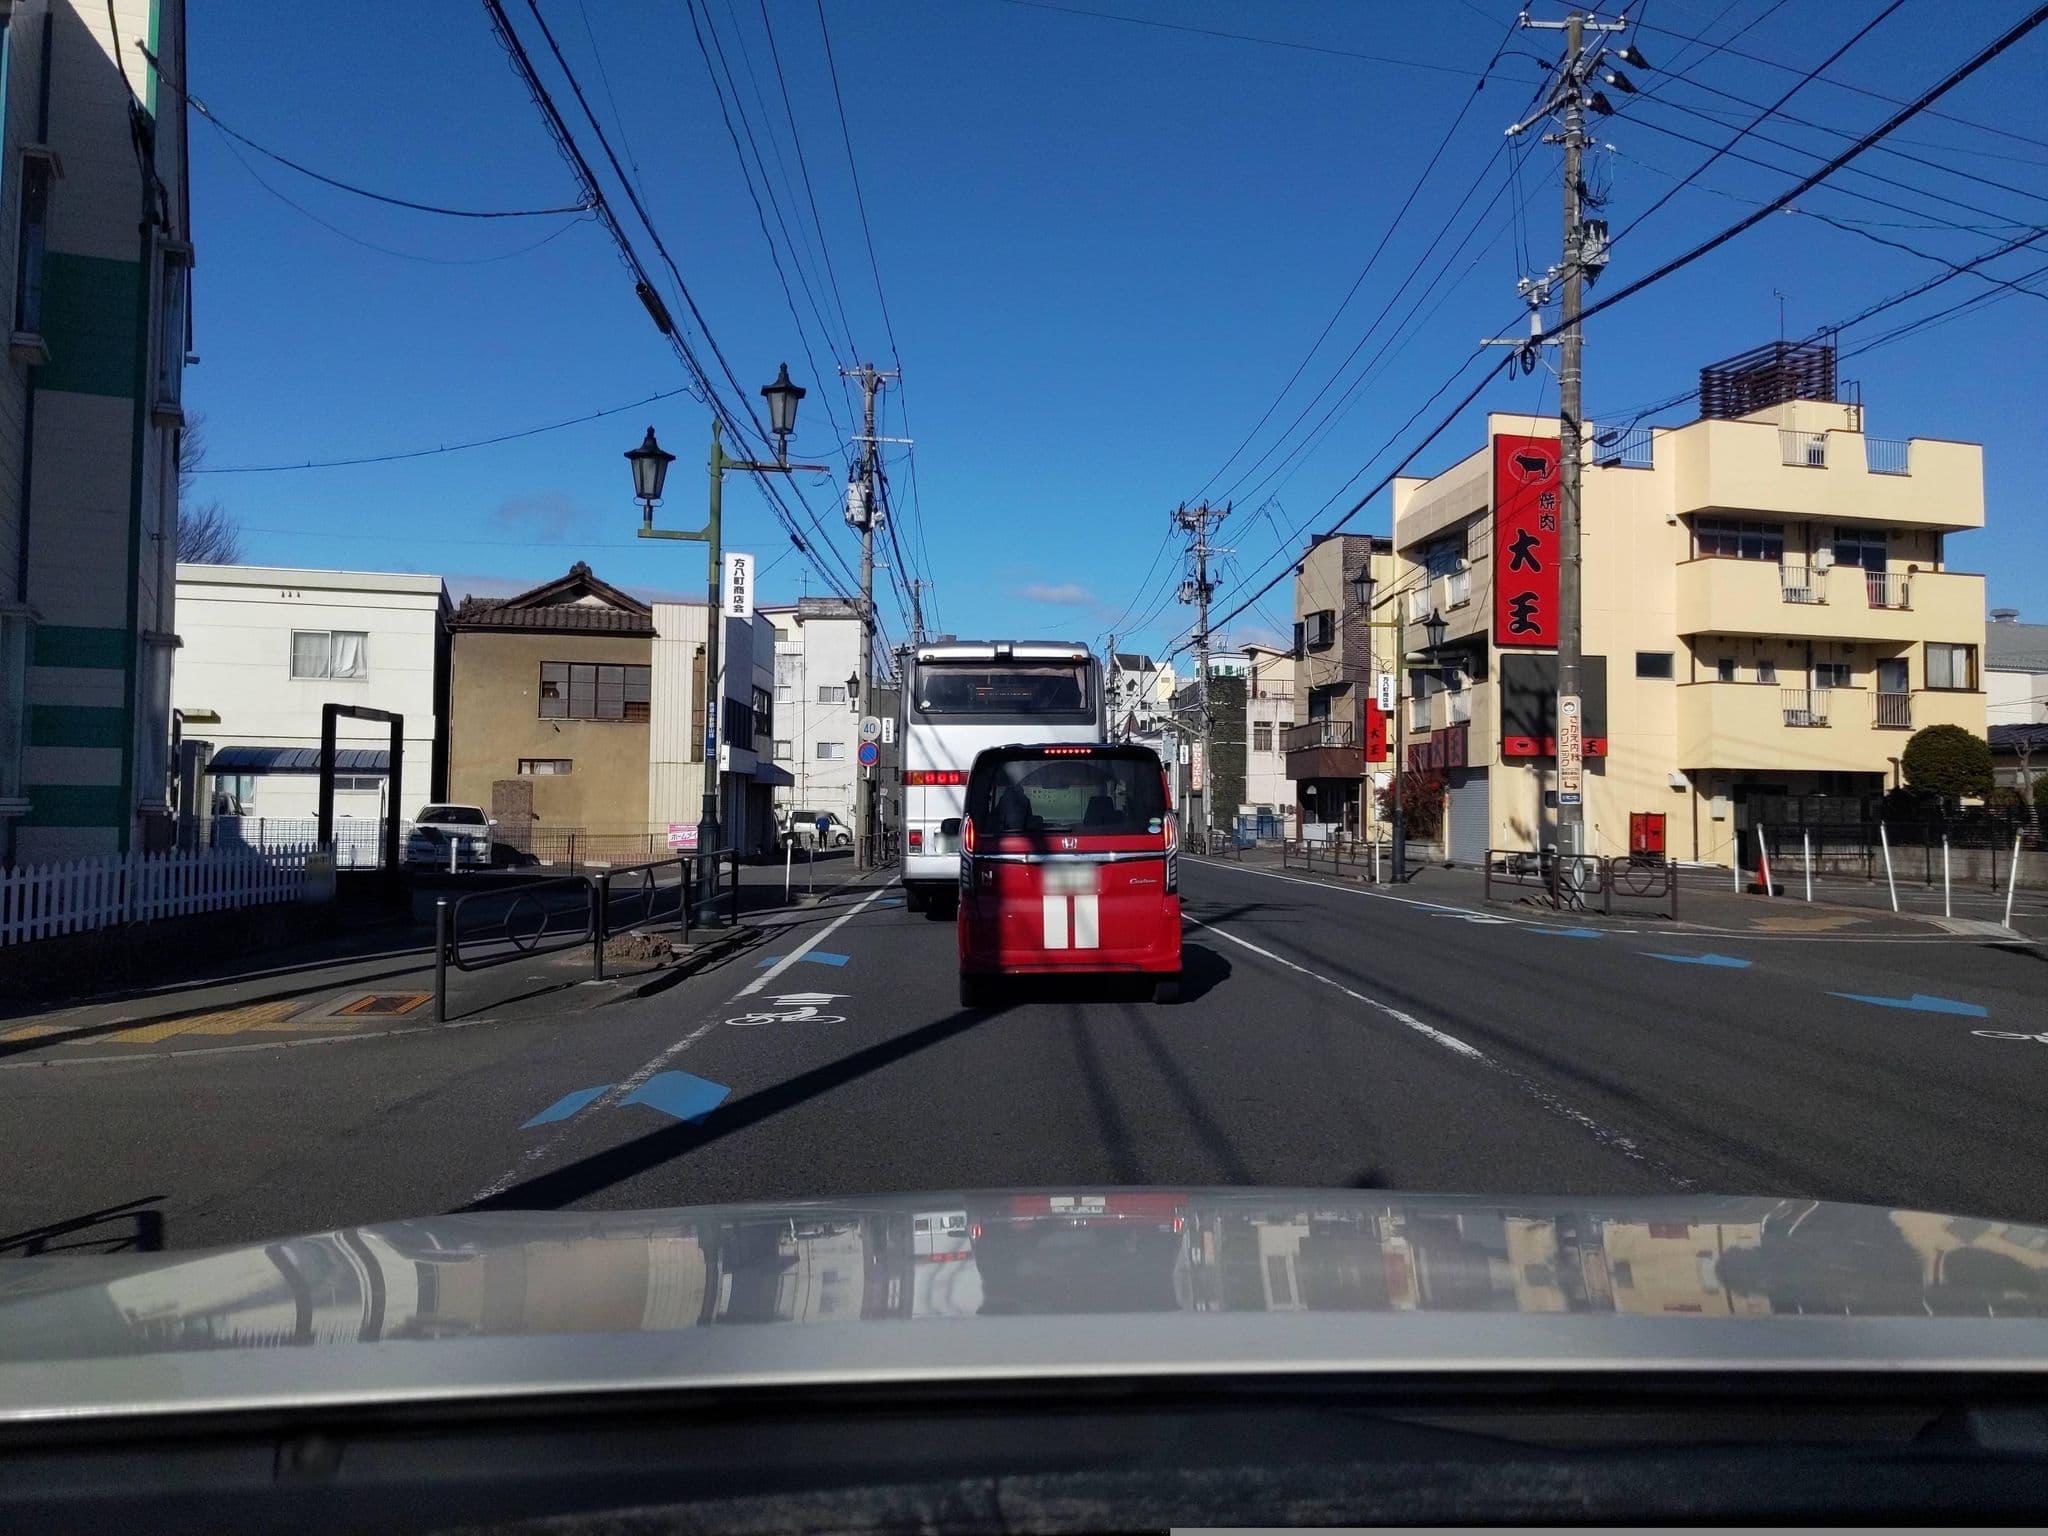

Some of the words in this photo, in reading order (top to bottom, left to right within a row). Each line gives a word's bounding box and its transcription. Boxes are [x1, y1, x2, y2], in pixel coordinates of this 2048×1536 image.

[1539, 491, 1556, 532] 焼肉
[732, 558, 745, 613] 方八町商店会
[1508, 528, 1542, 636] 大王
[863, 723, 876, 734] 40
[1561, 728, 1570, 767] クリニック
[671, 832, 697, 840] ホームメイ
